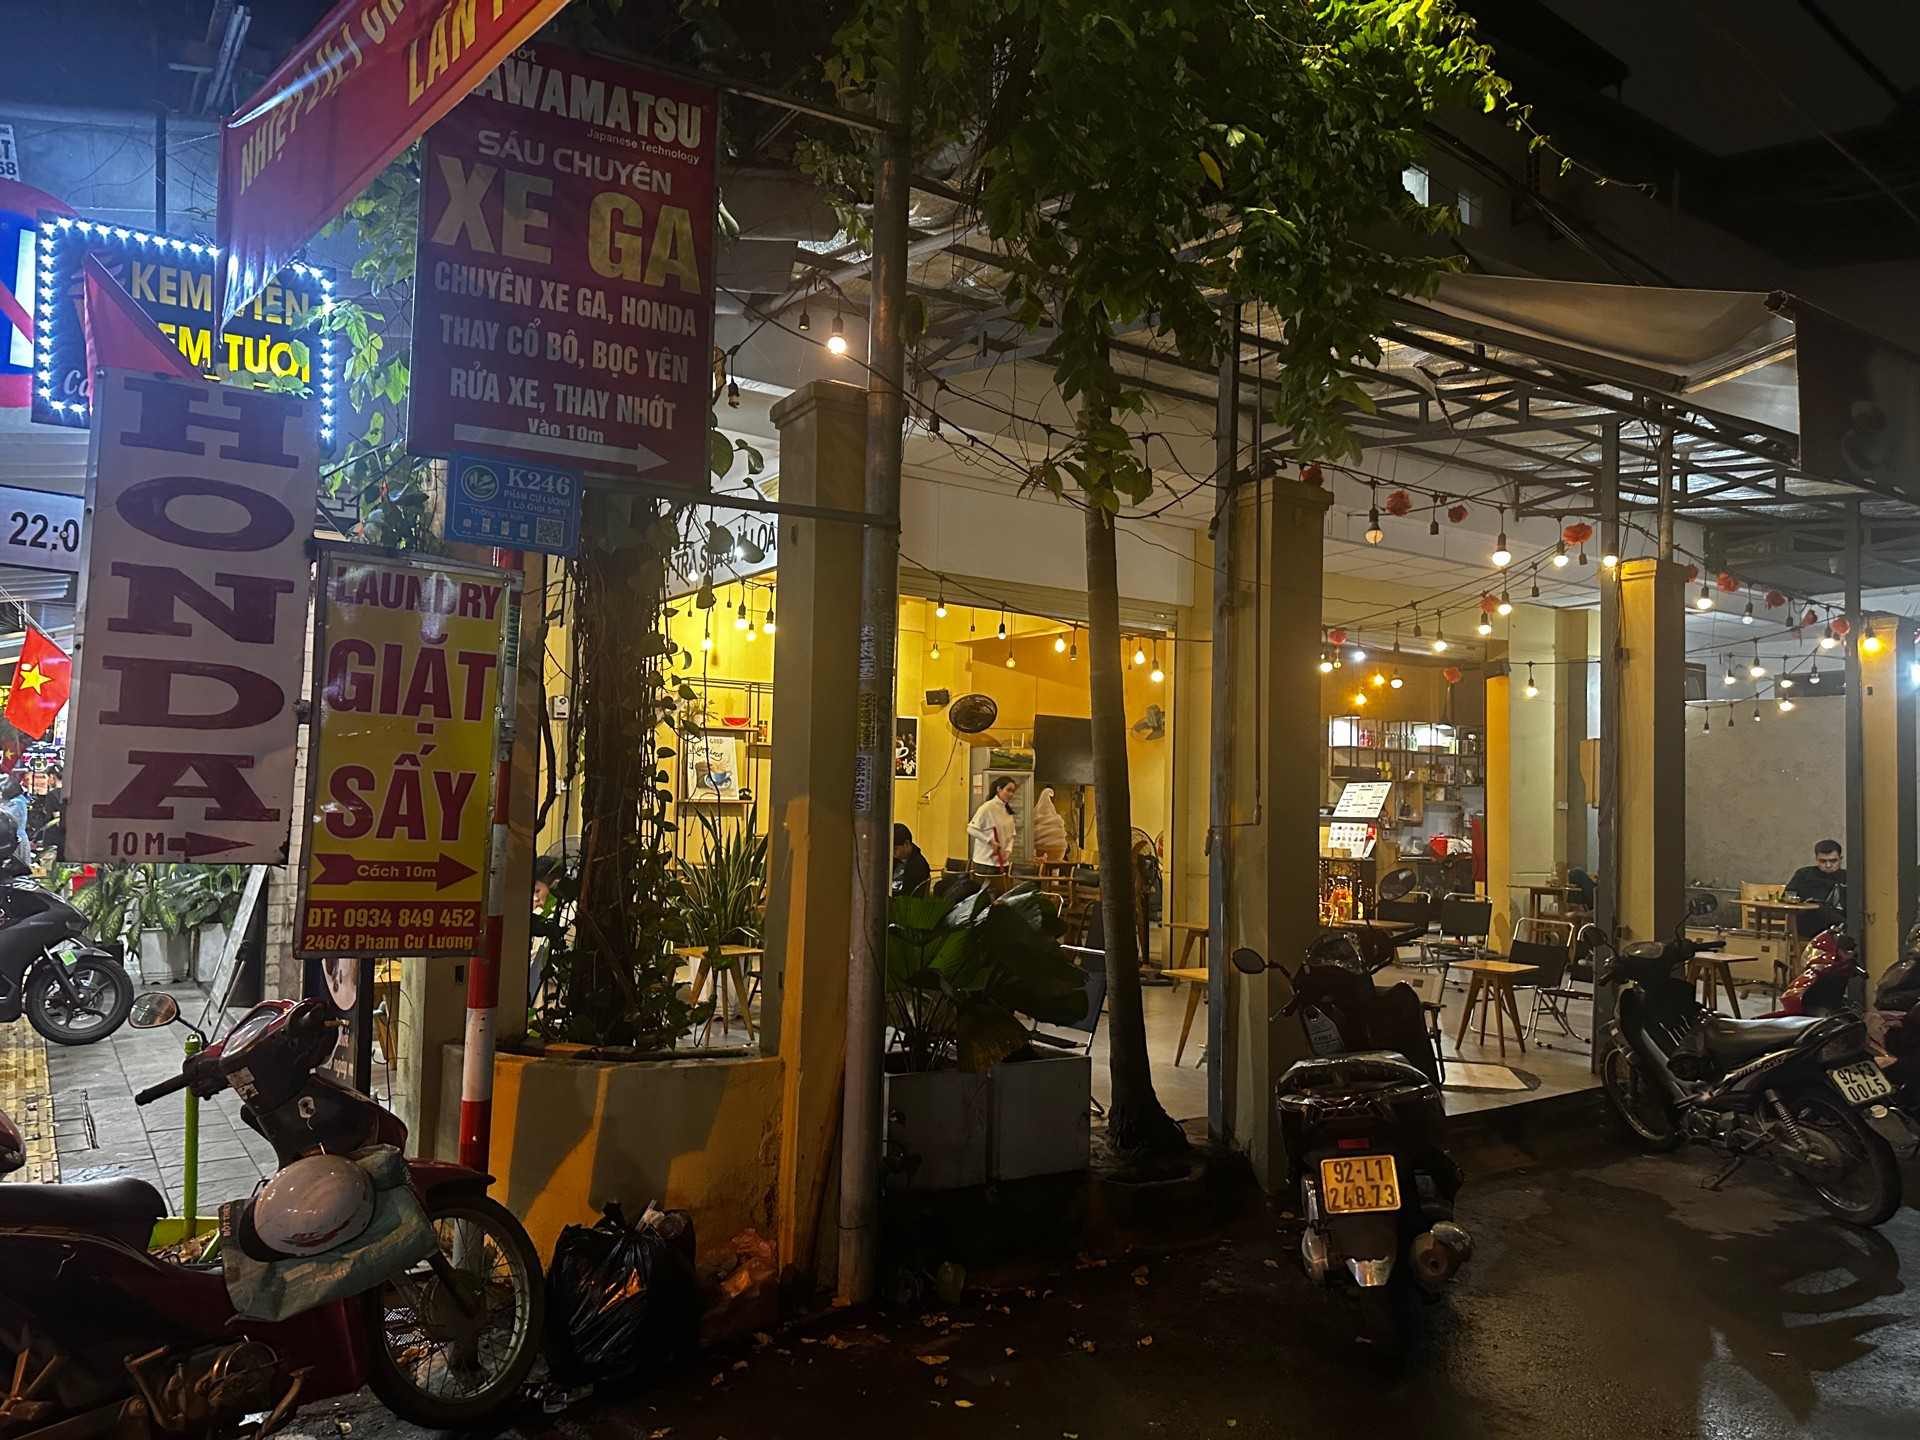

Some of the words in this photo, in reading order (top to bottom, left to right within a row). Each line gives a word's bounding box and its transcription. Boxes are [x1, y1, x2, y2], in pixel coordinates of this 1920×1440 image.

[471, 57, 702, 148] AWAMATSU
[478, 130, 545, 166] SÁU
[553, 148, 672, 195] CHUYÊN
[587, 128, 638, 148] Japanese
[641, 141, 700, 164] Technology
[430, 153, 553, 265] XE
[588, 191, 701, 295] GA
[132, 261, 212, 312] KEM
[434, 261, 533, 306] CHUYÊN
[539, 282, 570, 313] XE
[577, 287, 613, 324] GA,
[621, 296, 696, 337] HONDA
[439, 313, 500, 350] THAY
[507, 318, 541, 358] CỔ
[593, 340, 638, 378] BỌC
[646, 347, 689, 383] YÊN
[450, 361, 500, 402] RỬA
[508, 376, 546, 413] XE,
[554, 383, 610, 420] THAY
[617, 394, 676, 430] NHỚT
[528, 417, 561, 436] Vào
[567, 424, 604, 444] 10m
[506, 467, 570, 496] K246
[92, 377, 303, 822] HONDA
[334, 566, 503, 620] LAUNDRY
[327, 632, 497, 735] GIẶT
[326, 744, 477, 840] SẤY
[357, 864, 399, 878] Cách
[405, 865, 437, 878] 10m
[304, 934, 350, 950] 246/3
[307, 908, 337, 928] ĐT:
[343, 908, 392, 928] 0934
[398, 908, 434, 928] 849
[439, 908, 475, 928] 452
[1838, 1063, 1876, 1085] 92-F3
[1848, 1078, 1886, 1101] 0045
[1330, 1184, 1395, 1211] 248.73
[1333, 1160, 1384, 1184] 92-L1
